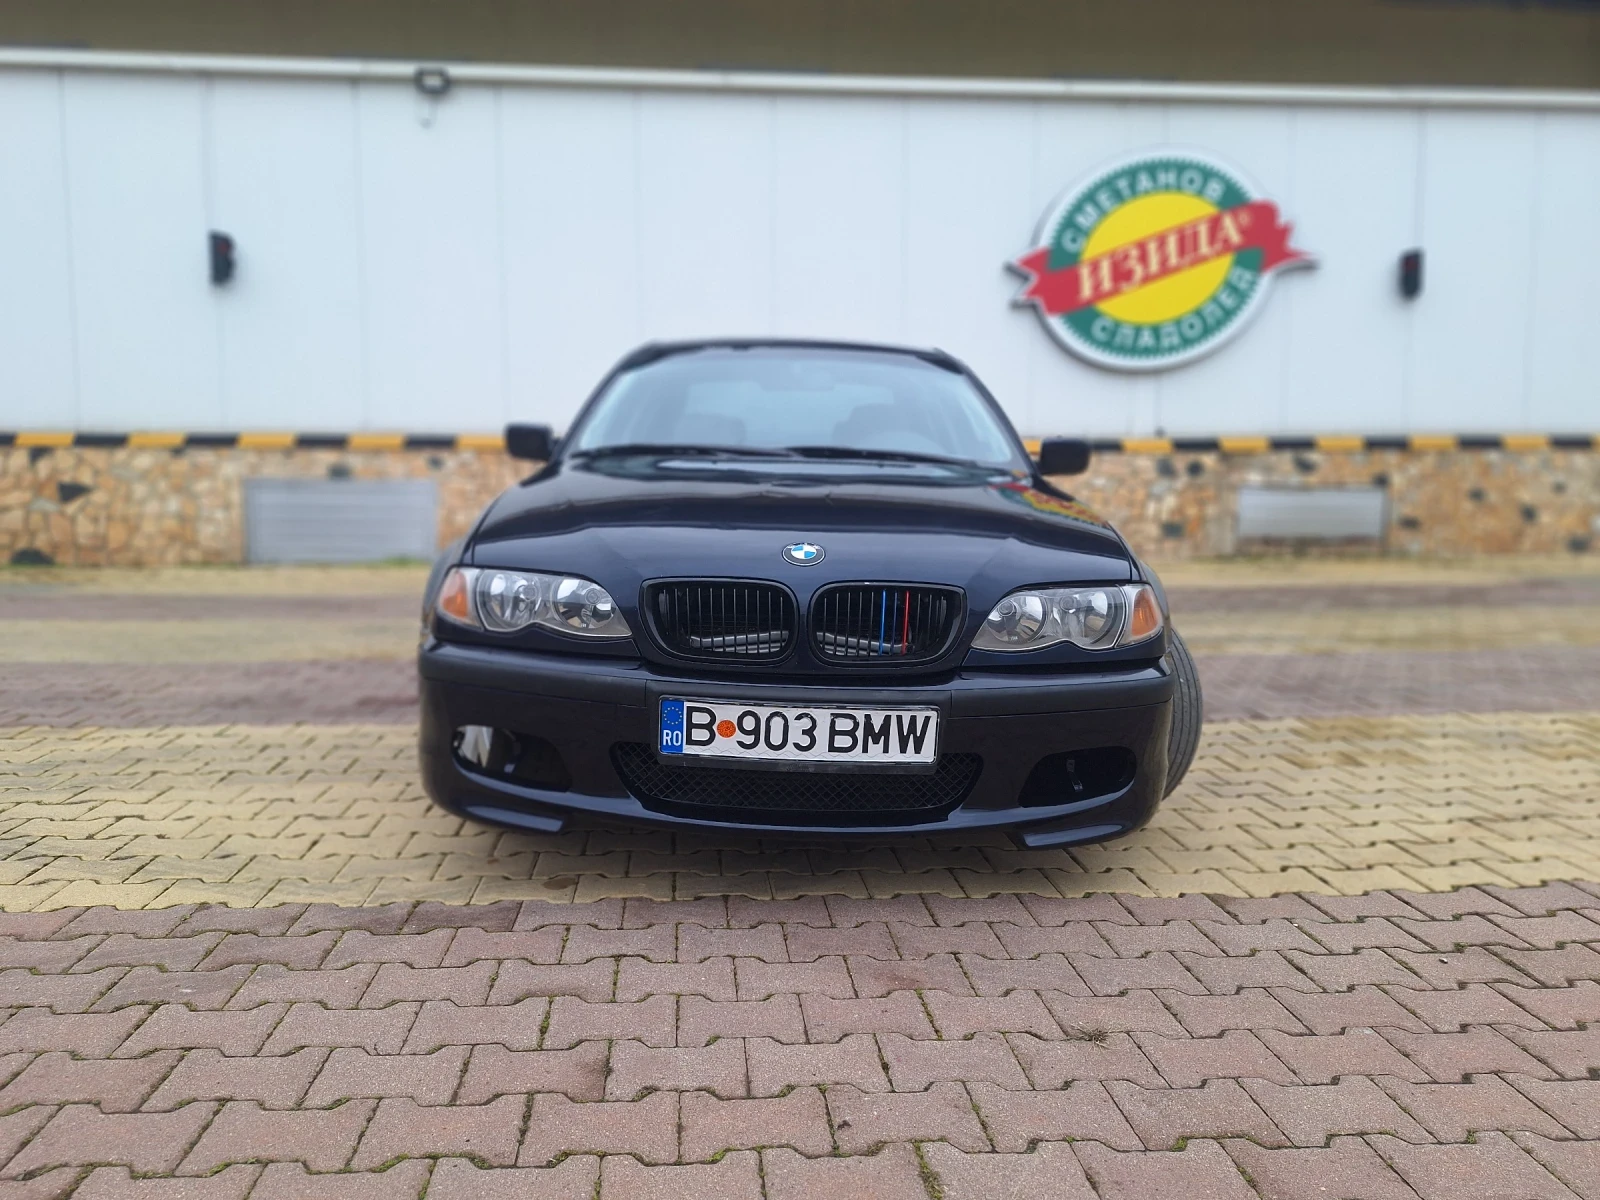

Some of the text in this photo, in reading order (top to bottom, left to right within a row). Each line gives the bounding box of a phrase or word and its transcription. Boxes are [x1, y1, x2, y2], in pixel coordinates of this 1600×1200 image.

[1060, 168, 1226, 253] СМЕТАНОВ
[1077, 211, 1243, 301] ИЗИДА
[1091, 264, 1255, 348] СЛАДОЛЕД
[662, 729, 682, 747] RO
[685, 706, 931, 755] B 903 BMW
